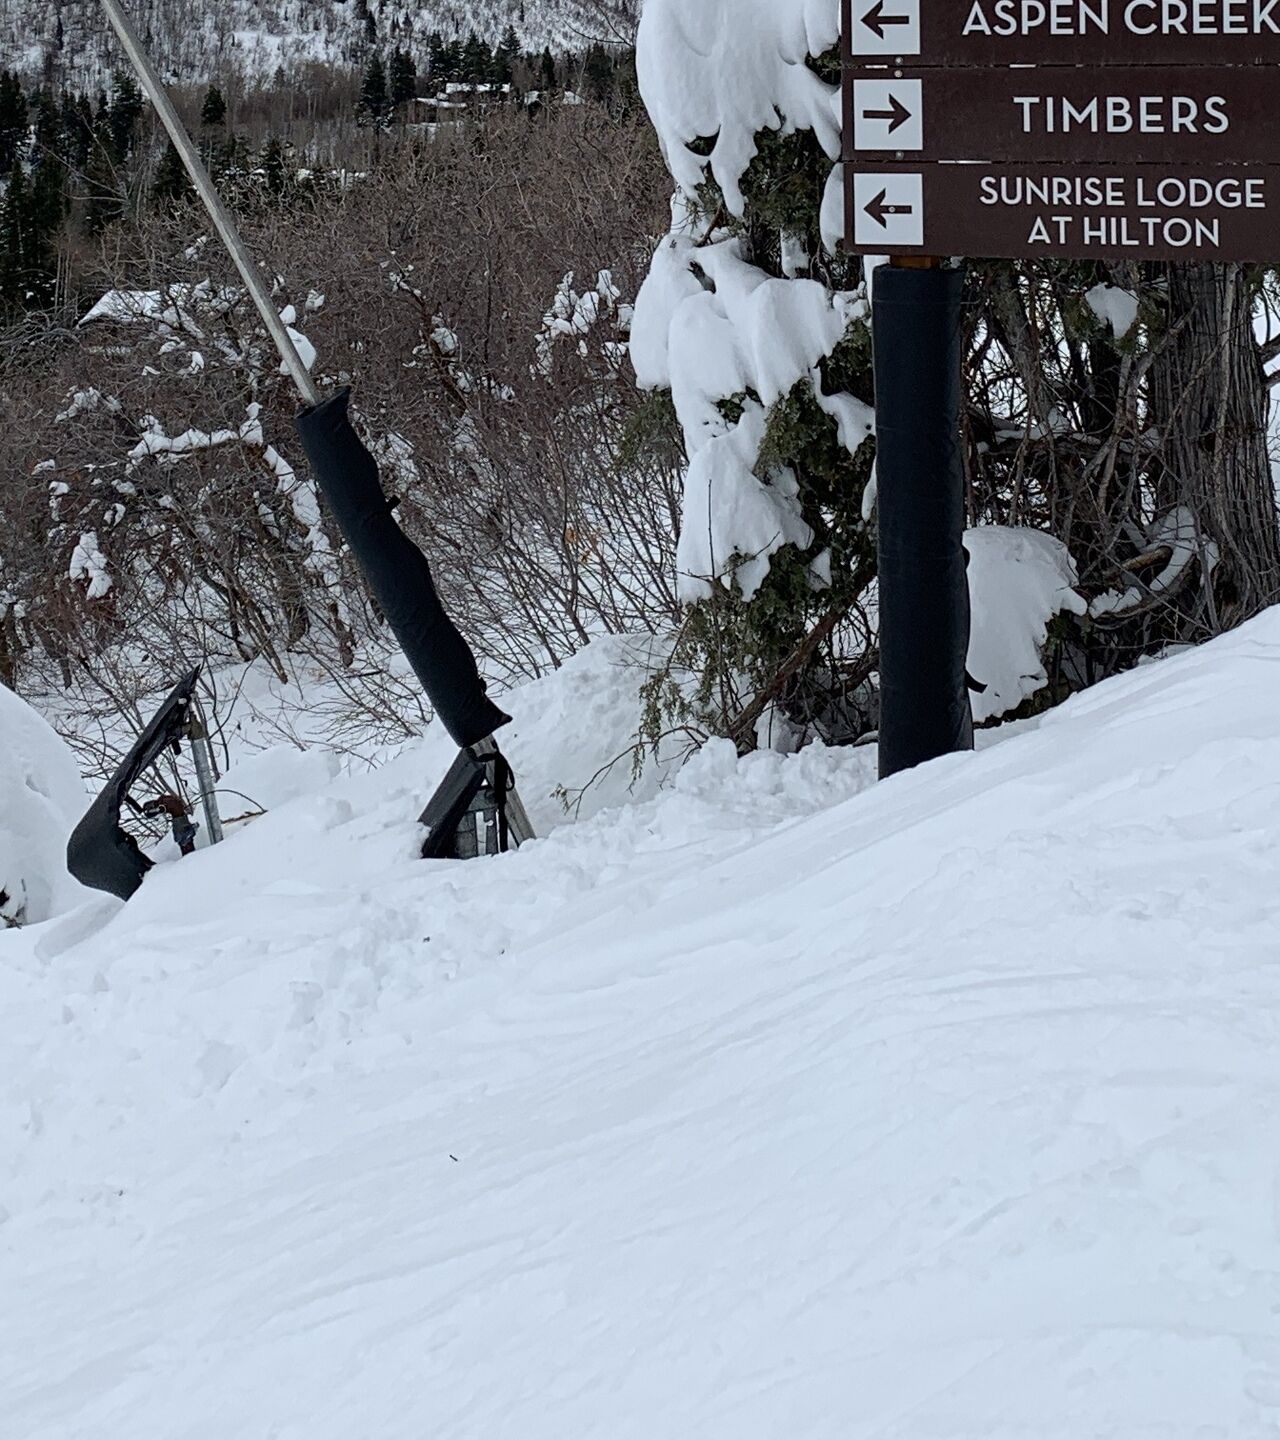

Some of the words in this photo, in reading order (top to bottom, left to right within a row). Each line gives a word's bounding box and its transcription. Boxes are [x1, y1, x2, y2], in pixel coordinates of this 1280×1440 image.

[1013, 96, 1229, 133] TIMBERS
[979, 176, 1125, 206] SUNRISE
[1137, 178, 1266, 208] LODGE
[1027, 216, 1073, 244] AT
[1083, 216, 1219, 247] HILTON
